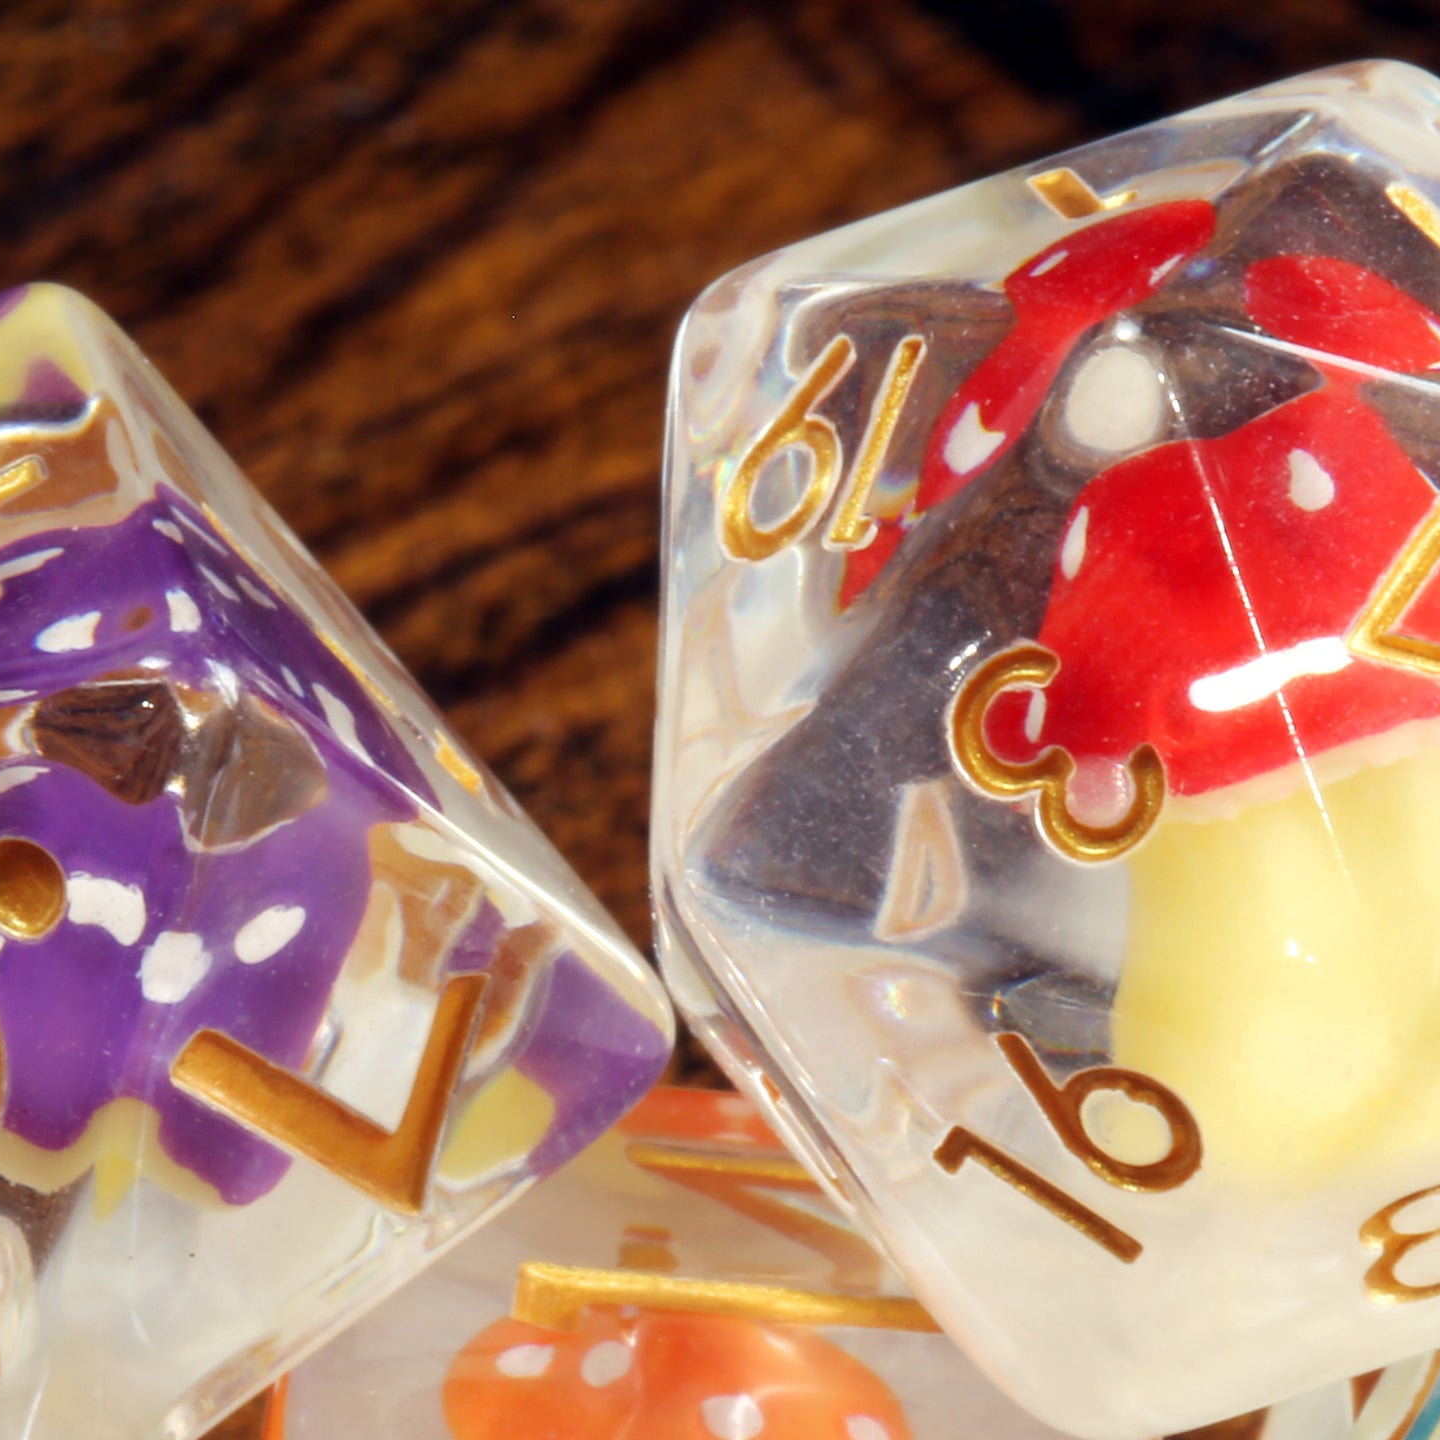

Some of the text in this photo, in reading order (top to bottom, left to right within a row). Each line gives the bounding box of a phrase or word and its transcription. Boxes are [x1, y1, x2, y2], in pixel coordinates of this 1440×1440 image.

[718, 333, 926, 562] 19
[948, 642, 1166, 867] 3
[933, 1033, 1202, 1265] 16
